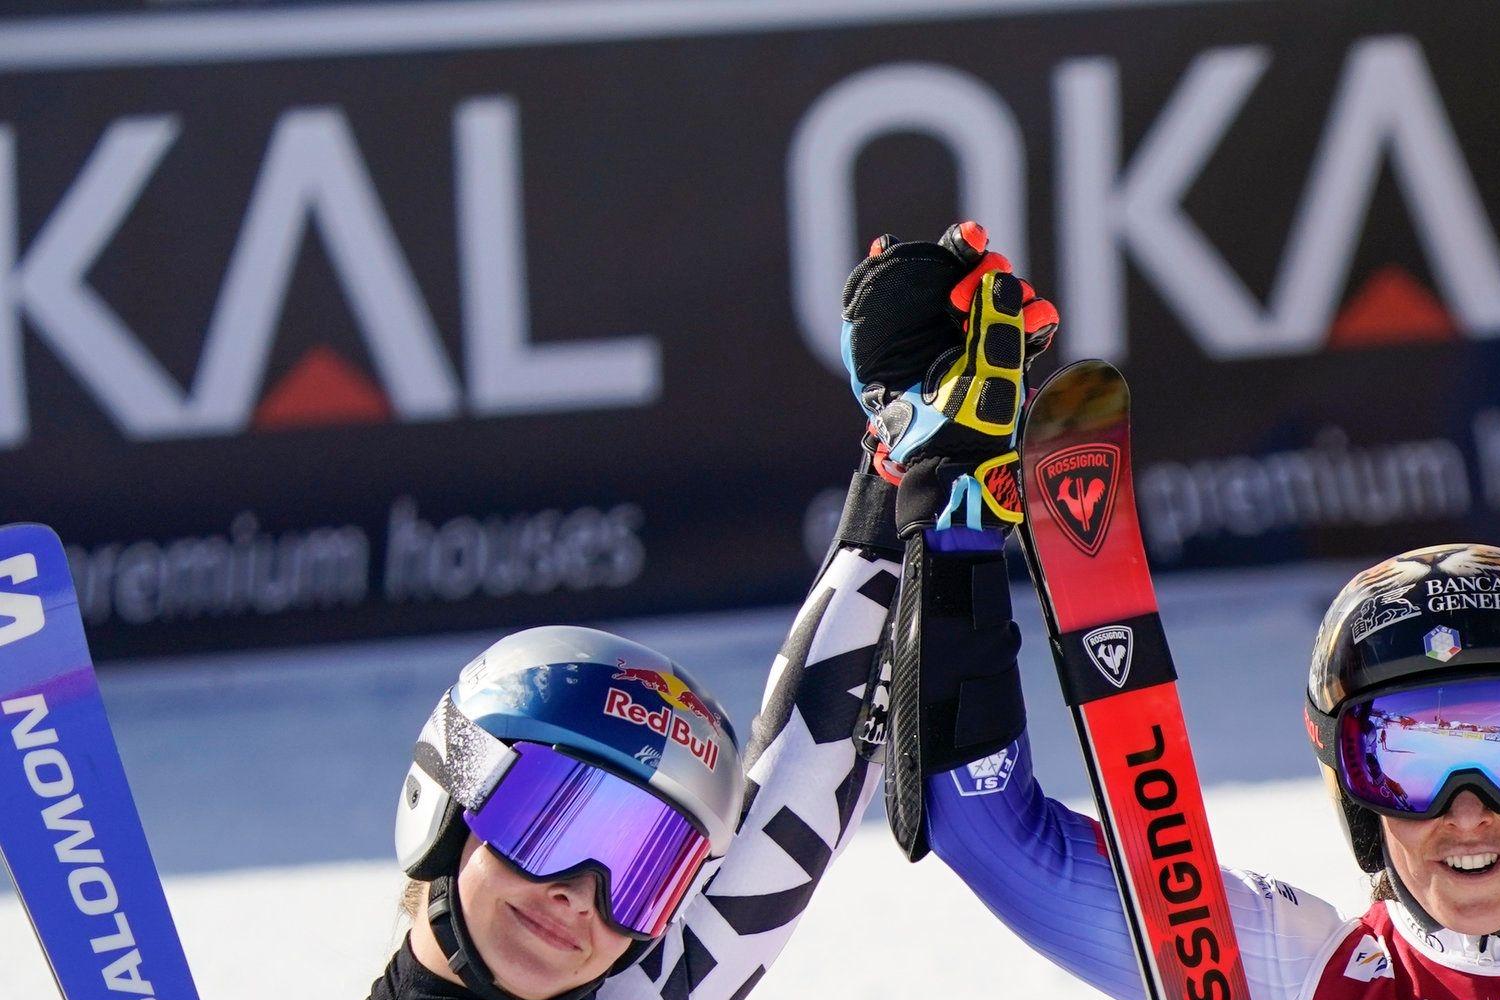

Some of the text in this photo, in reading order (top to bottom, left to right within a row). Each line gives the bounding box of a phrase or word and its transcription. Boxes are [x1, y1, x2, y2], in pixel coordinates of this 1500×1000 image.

[1047, 452, 1110, 479] ROSSIGNOL
[1090, 631, 1127, 647] ROSSIGNOL
[604, 688, 719, 773] Red Bull
